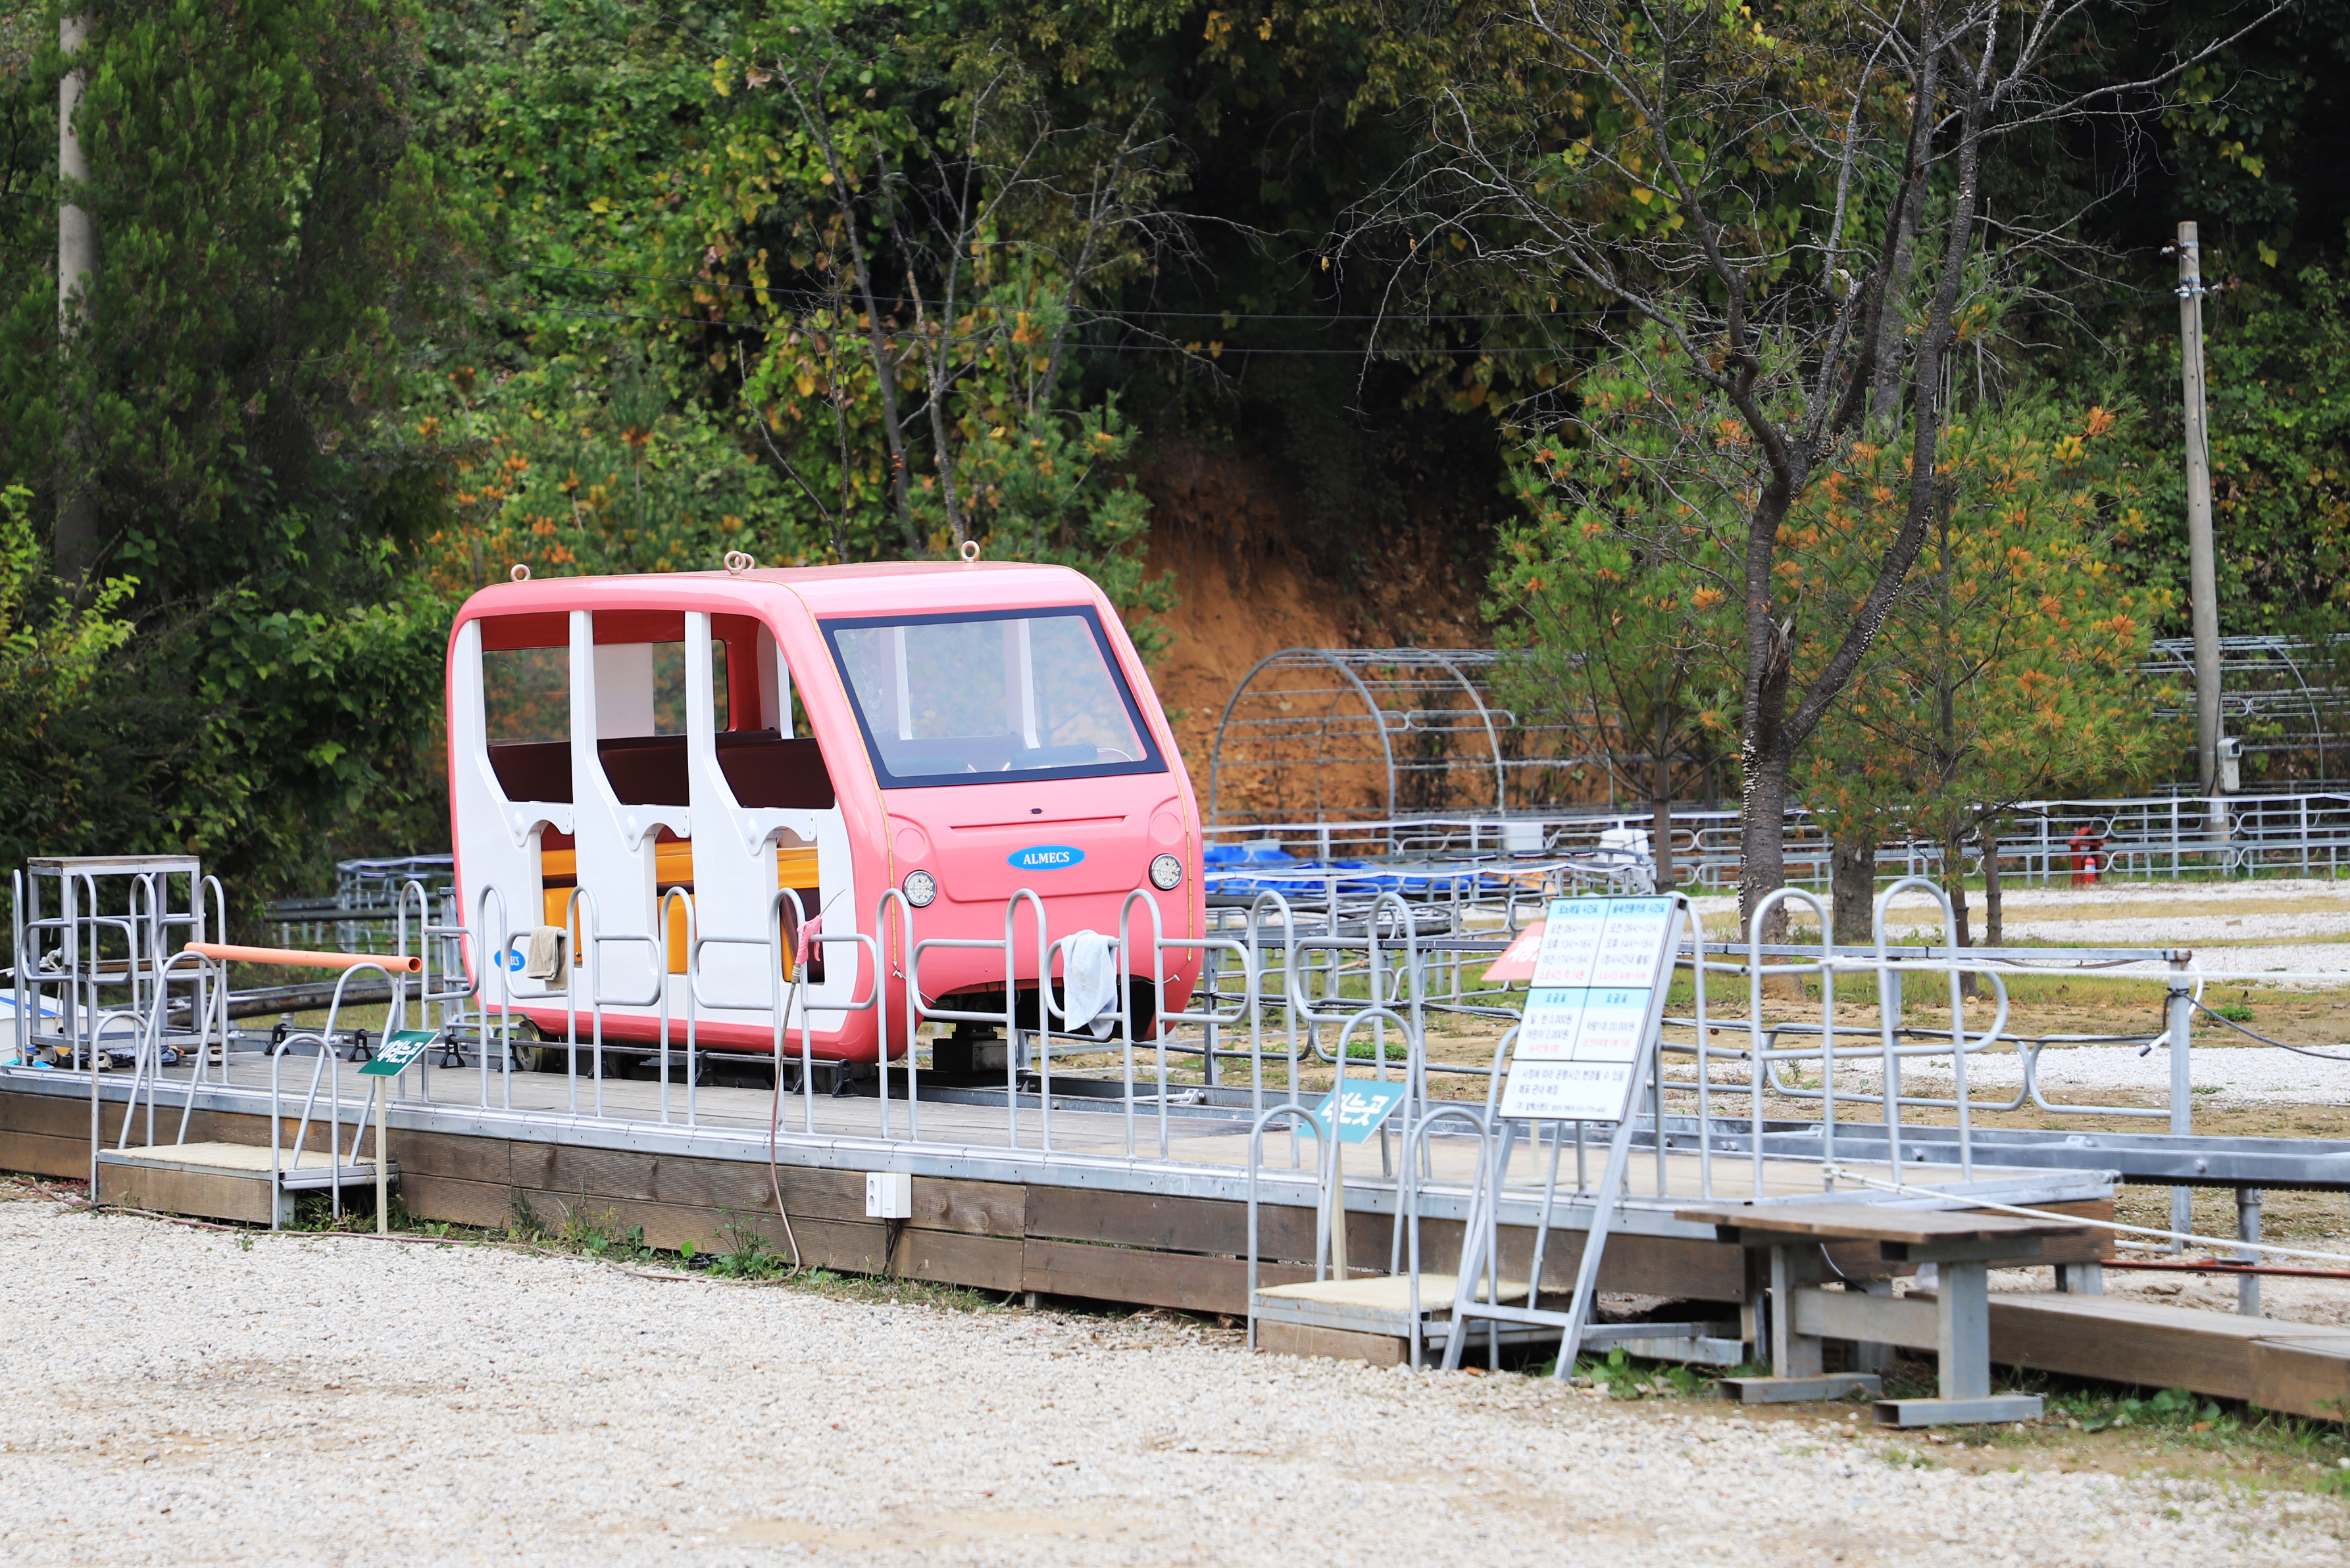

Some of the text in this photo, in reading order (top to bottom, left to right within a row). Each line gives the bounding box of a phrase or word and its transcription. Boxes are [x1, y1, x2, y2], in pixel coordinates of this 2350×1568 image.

[1023, 851, 1070, 865] ALMECS
[1558, 904, 1599, 914] 모노레일 시간표
[1649, 904, 1666, 912] 시간표
[1550, 923, 1563, 933] 오전
[1609, 923, 1622, 933] 오전
[1546, 939, 1559, 948] 오후
[1605, 938, 1618, 948] 오후
[1542, 954, 1555, 964] 야간
[1539, 969, 1562, 979] 소요시간
[377, 1040, 424, 1064] 내리는곳
